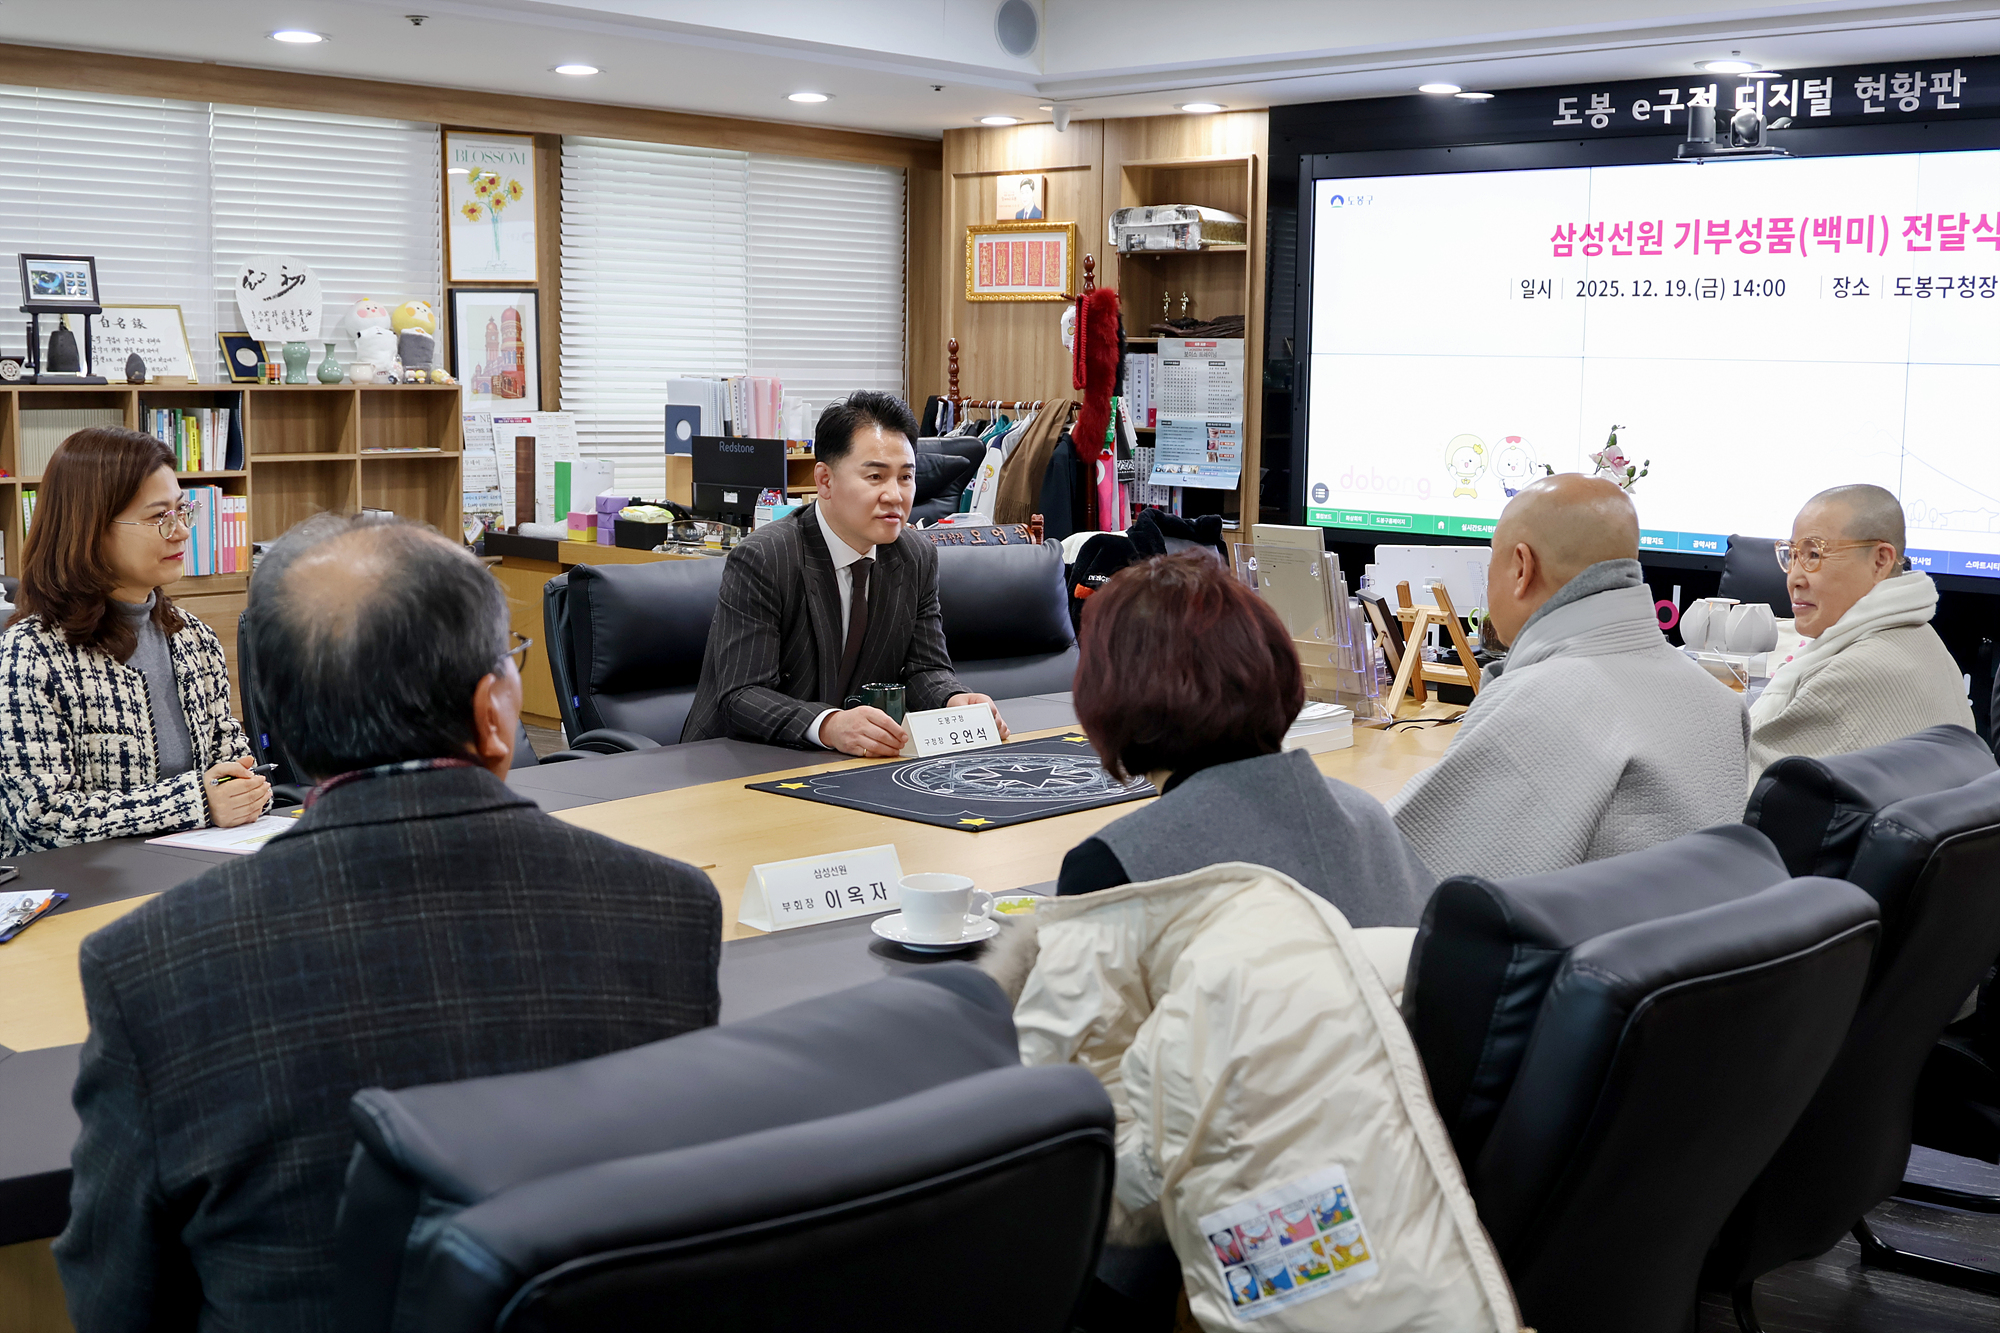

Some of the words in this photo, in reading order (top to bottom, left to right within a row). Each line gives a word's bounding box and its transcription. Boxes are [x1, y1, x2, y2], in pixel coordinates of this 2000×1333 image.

[1552, 91, 1616, 129] 도봉
[1735, 76, 1834, 117] 디지털
[1855, 68, 1967, 114] 현황판
[455, 149, 526, 166] BLOSSOM
[1550, 220, 1664, 258] 삼성선원
[1673, 214, 1890, 258] 기부성품(백미)
[1520, 278, 1552, 299] 일시
[1575, 279, 1626, 298] 2025.
[1631, 279, 1659, 298] 12.
[1663, 276, 1726, 301] 19.(금)
[1731, 278, 1787, 298] 14:00
[1832, 277, 1871, 298] 장소
[1893, 275, 2000, 299] 도봉구청장
[719, 440, 755, 454] Redstone
[1340, 465, 1432, 500] dobong
[924, 532, 965, 544] 봉구청장
[1908, 556, 1932, 566] 안사업
[949, 727, 988, 746] 오언석
[813, 864, 848, 880] 삼성선원
[781, 897, 815, 912] 부회장
[825, 881, 888, 909] 이옥자
